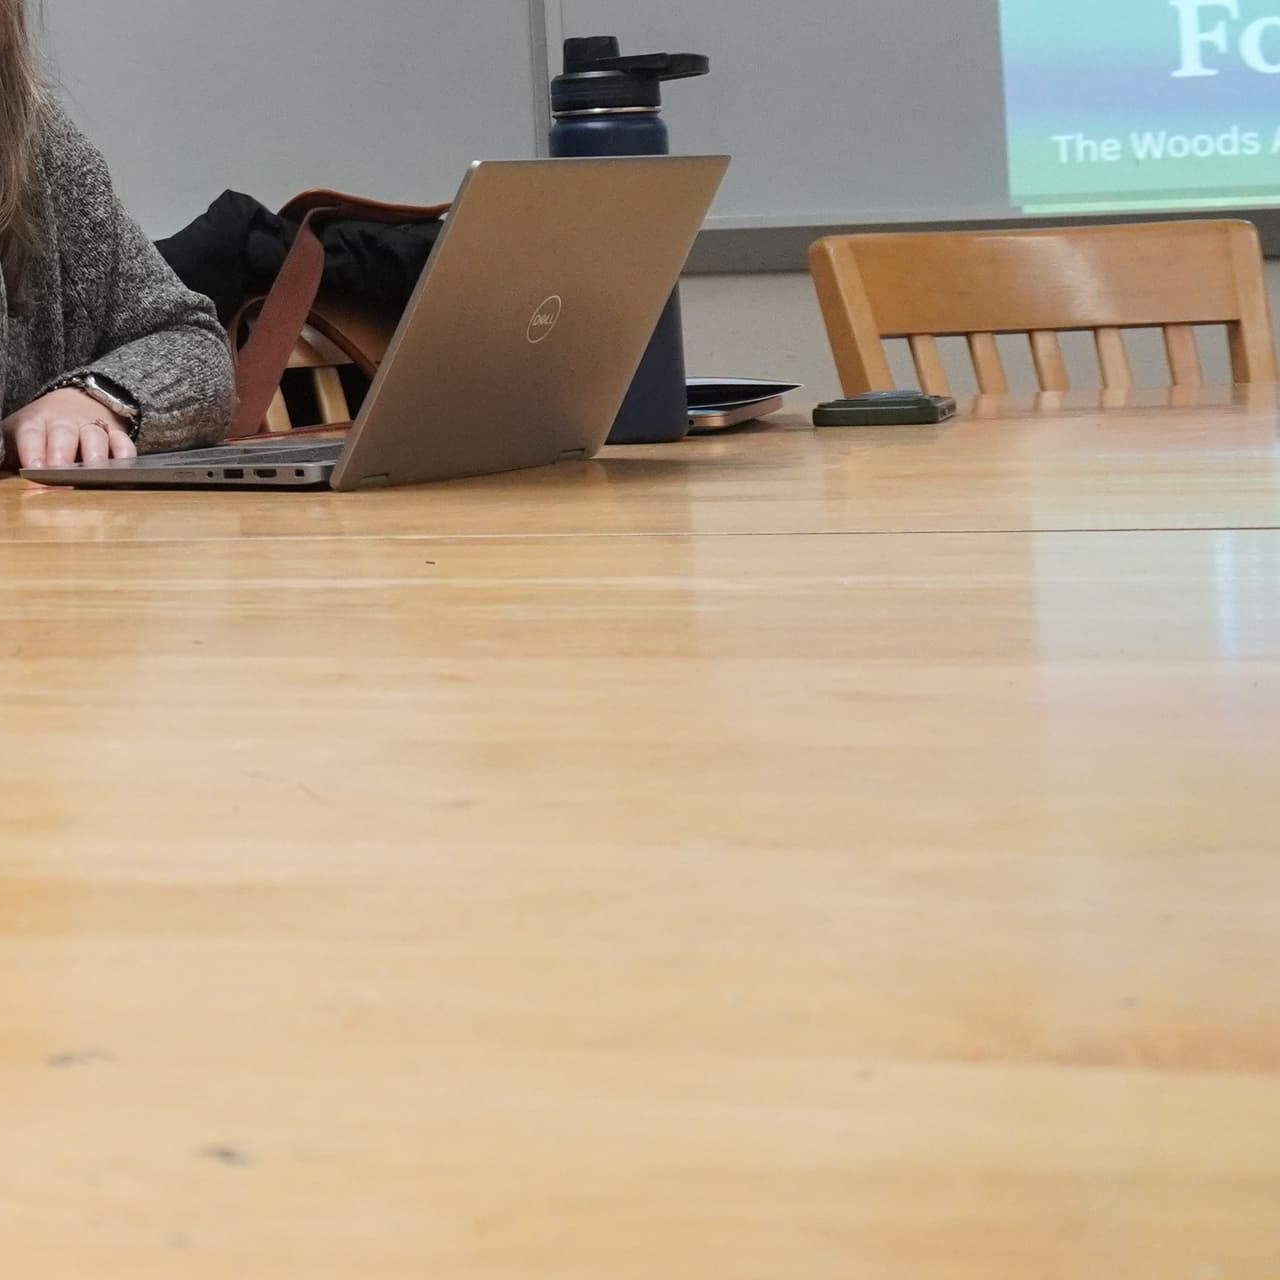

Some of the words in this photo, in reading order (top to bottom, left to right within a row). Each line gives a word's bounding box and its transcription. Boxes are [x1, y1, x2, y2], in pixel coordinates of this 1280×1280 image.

[1050, 132, 1122, 164] The
[1130, 125, 1261, 161] Woods
[532, 313, 555, 326] DELL
